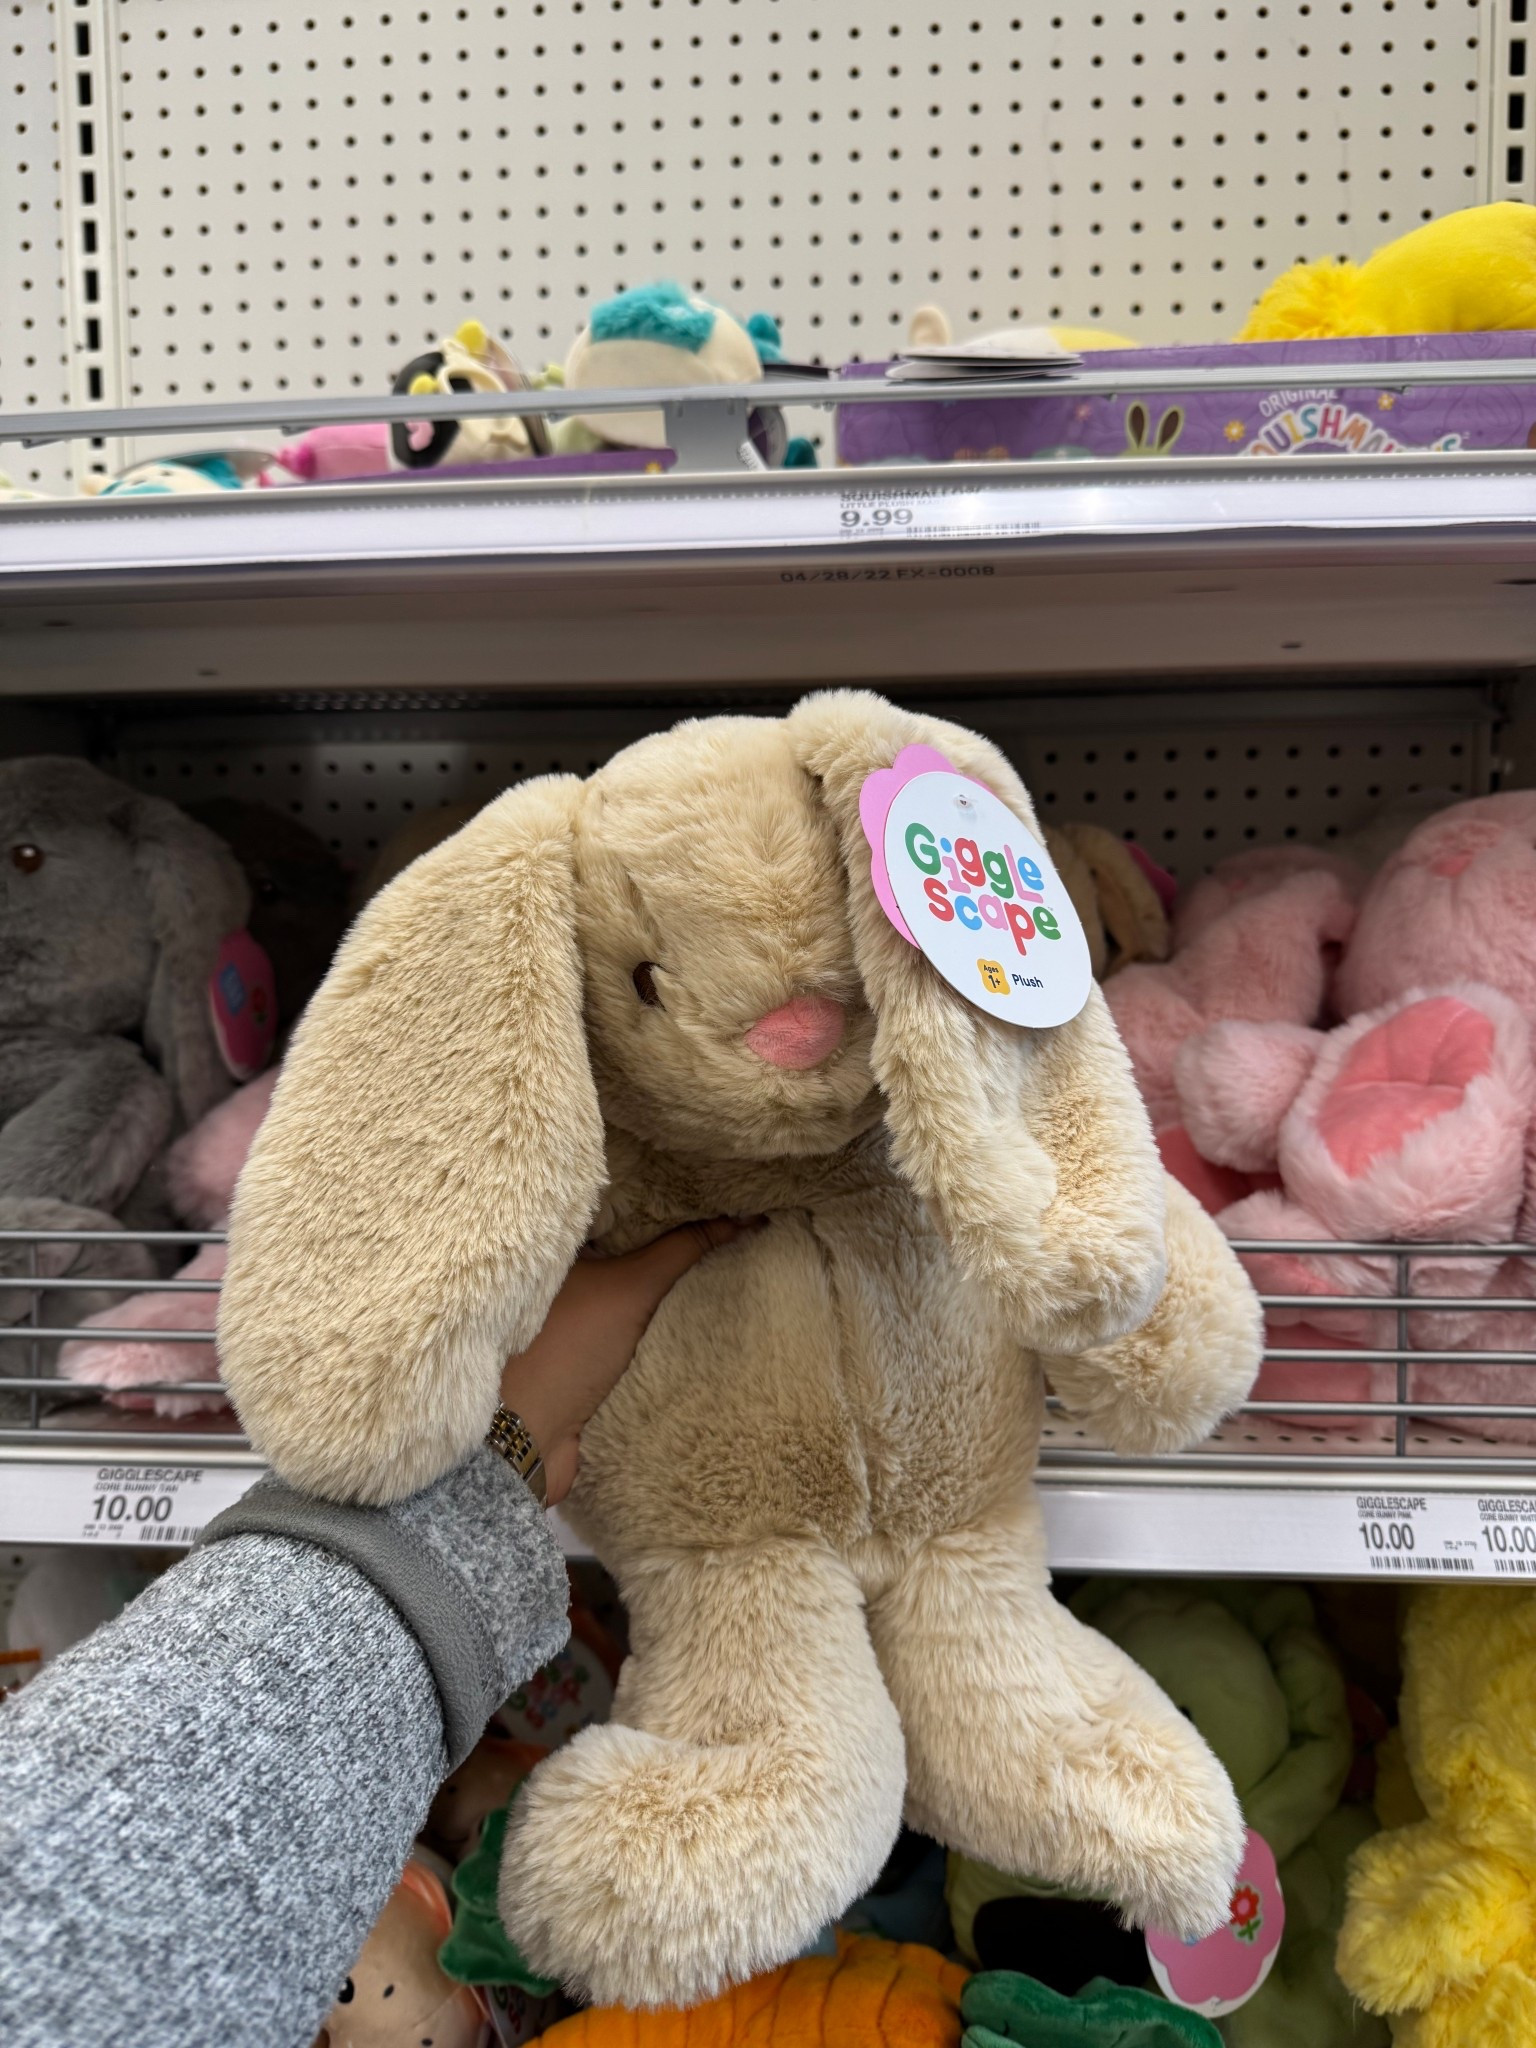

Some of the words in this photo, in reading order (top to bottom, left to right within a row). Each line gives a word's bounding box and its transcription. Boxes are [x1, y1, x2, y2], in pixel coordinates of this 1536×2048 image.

[840, 508, 913, 527] 9.99
[780, 569, 891, 583] 04/28/22
[905, 822, 1045, 904] Giggle
[983, 964, 999, 974] Ages
[988, 975, 1001, 989] 1+
[1011, 973, 1044, 989] Plush
[97, 1467, 204, 1483] GIGGLESCAPE
[124, 1482, 156, 1492] BUNNY
[92, 1494, 173, 1522] 10.00
[1356, 1495, 1427, 1511] GIGGLESCAPE
[1477, 1498, 1536, 1513] GIGGLESCA
[1376, 1510, 1396, 1519] BUNNY
[1358, 1521, 1415, 1550] 10.00
[1481, 1524, 1536, 1553] 10.00
